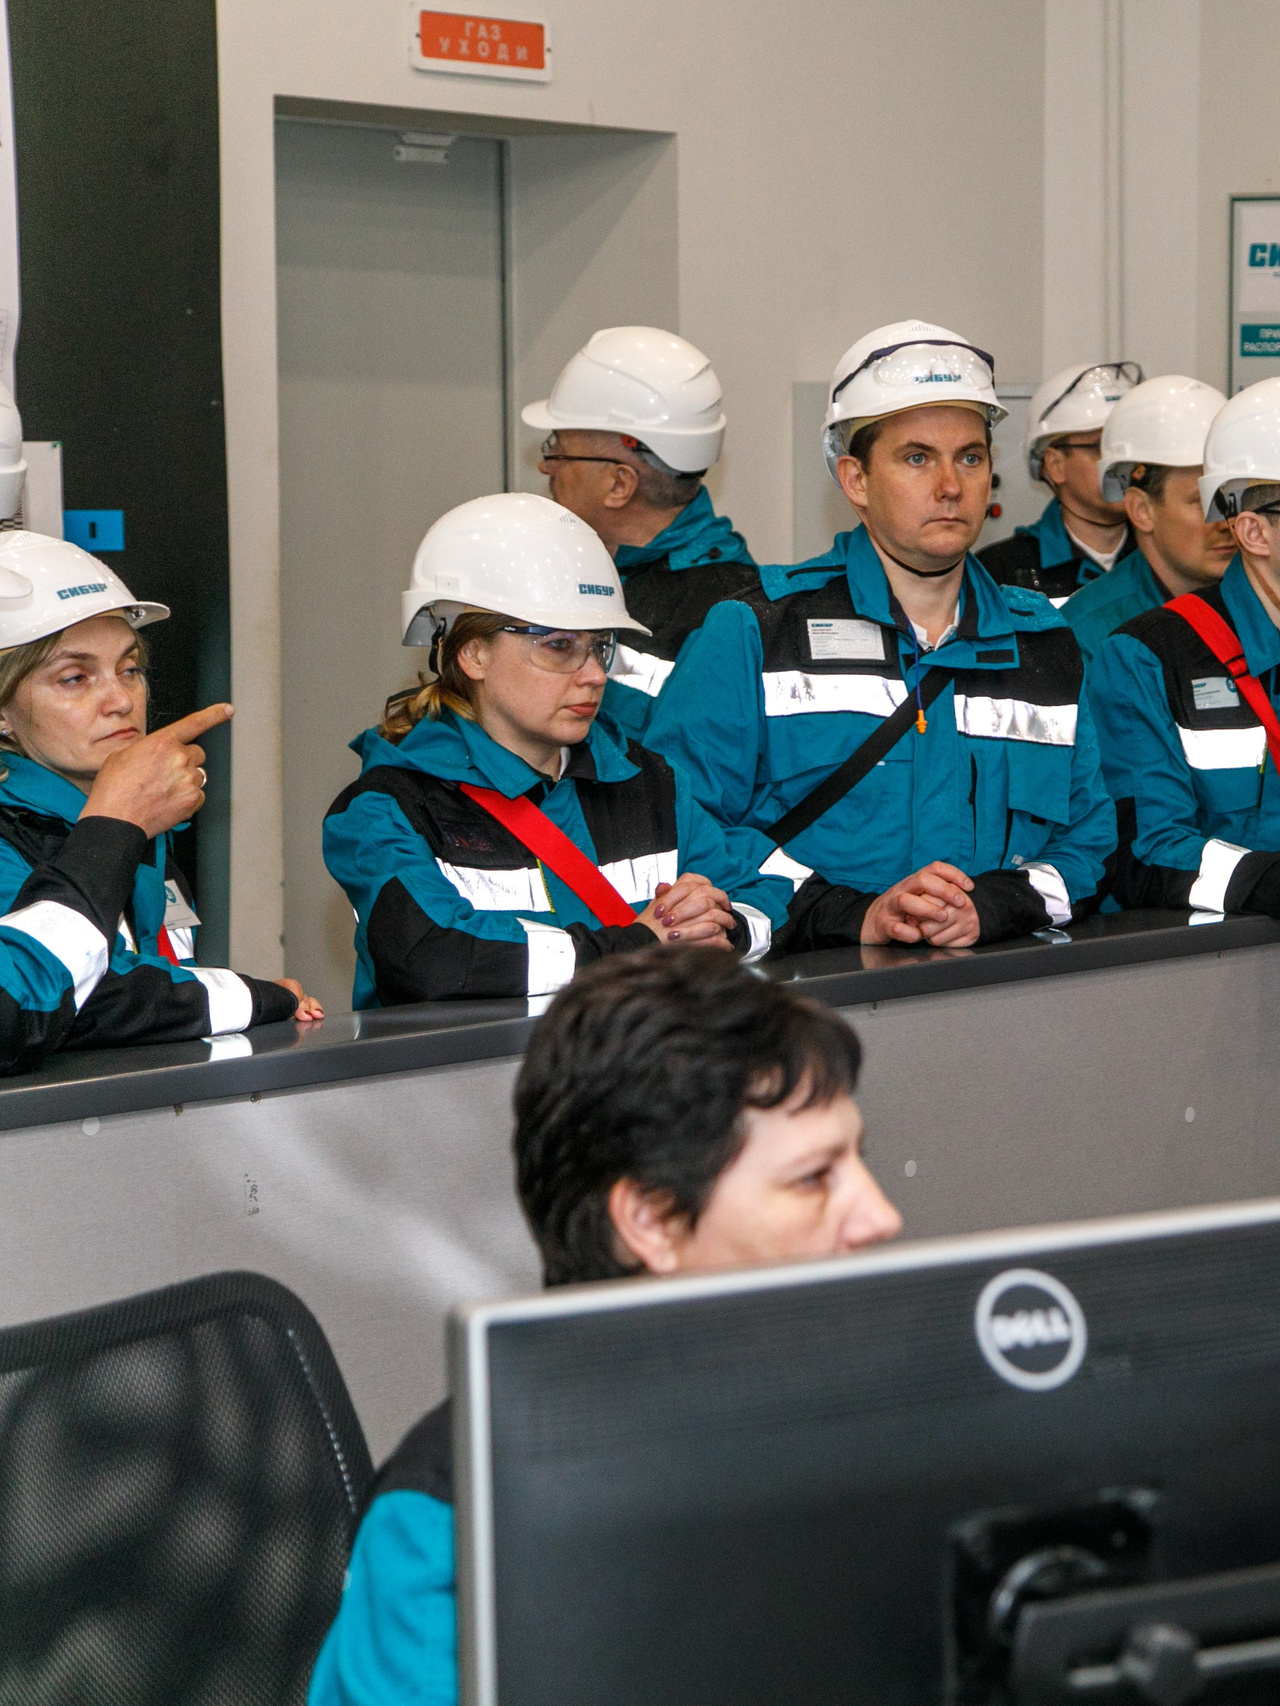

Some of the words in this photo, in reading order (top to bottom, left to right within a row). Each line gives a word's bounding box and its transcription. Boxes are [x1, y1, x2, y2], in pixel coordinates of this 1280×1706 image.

[464, 21, 501, 40] ГАЗ
[439, 36, 529, 62] УХОДИ
[57, 583, 108, 600] СИБУР
[578, 584, 615, 597] СИБУР
